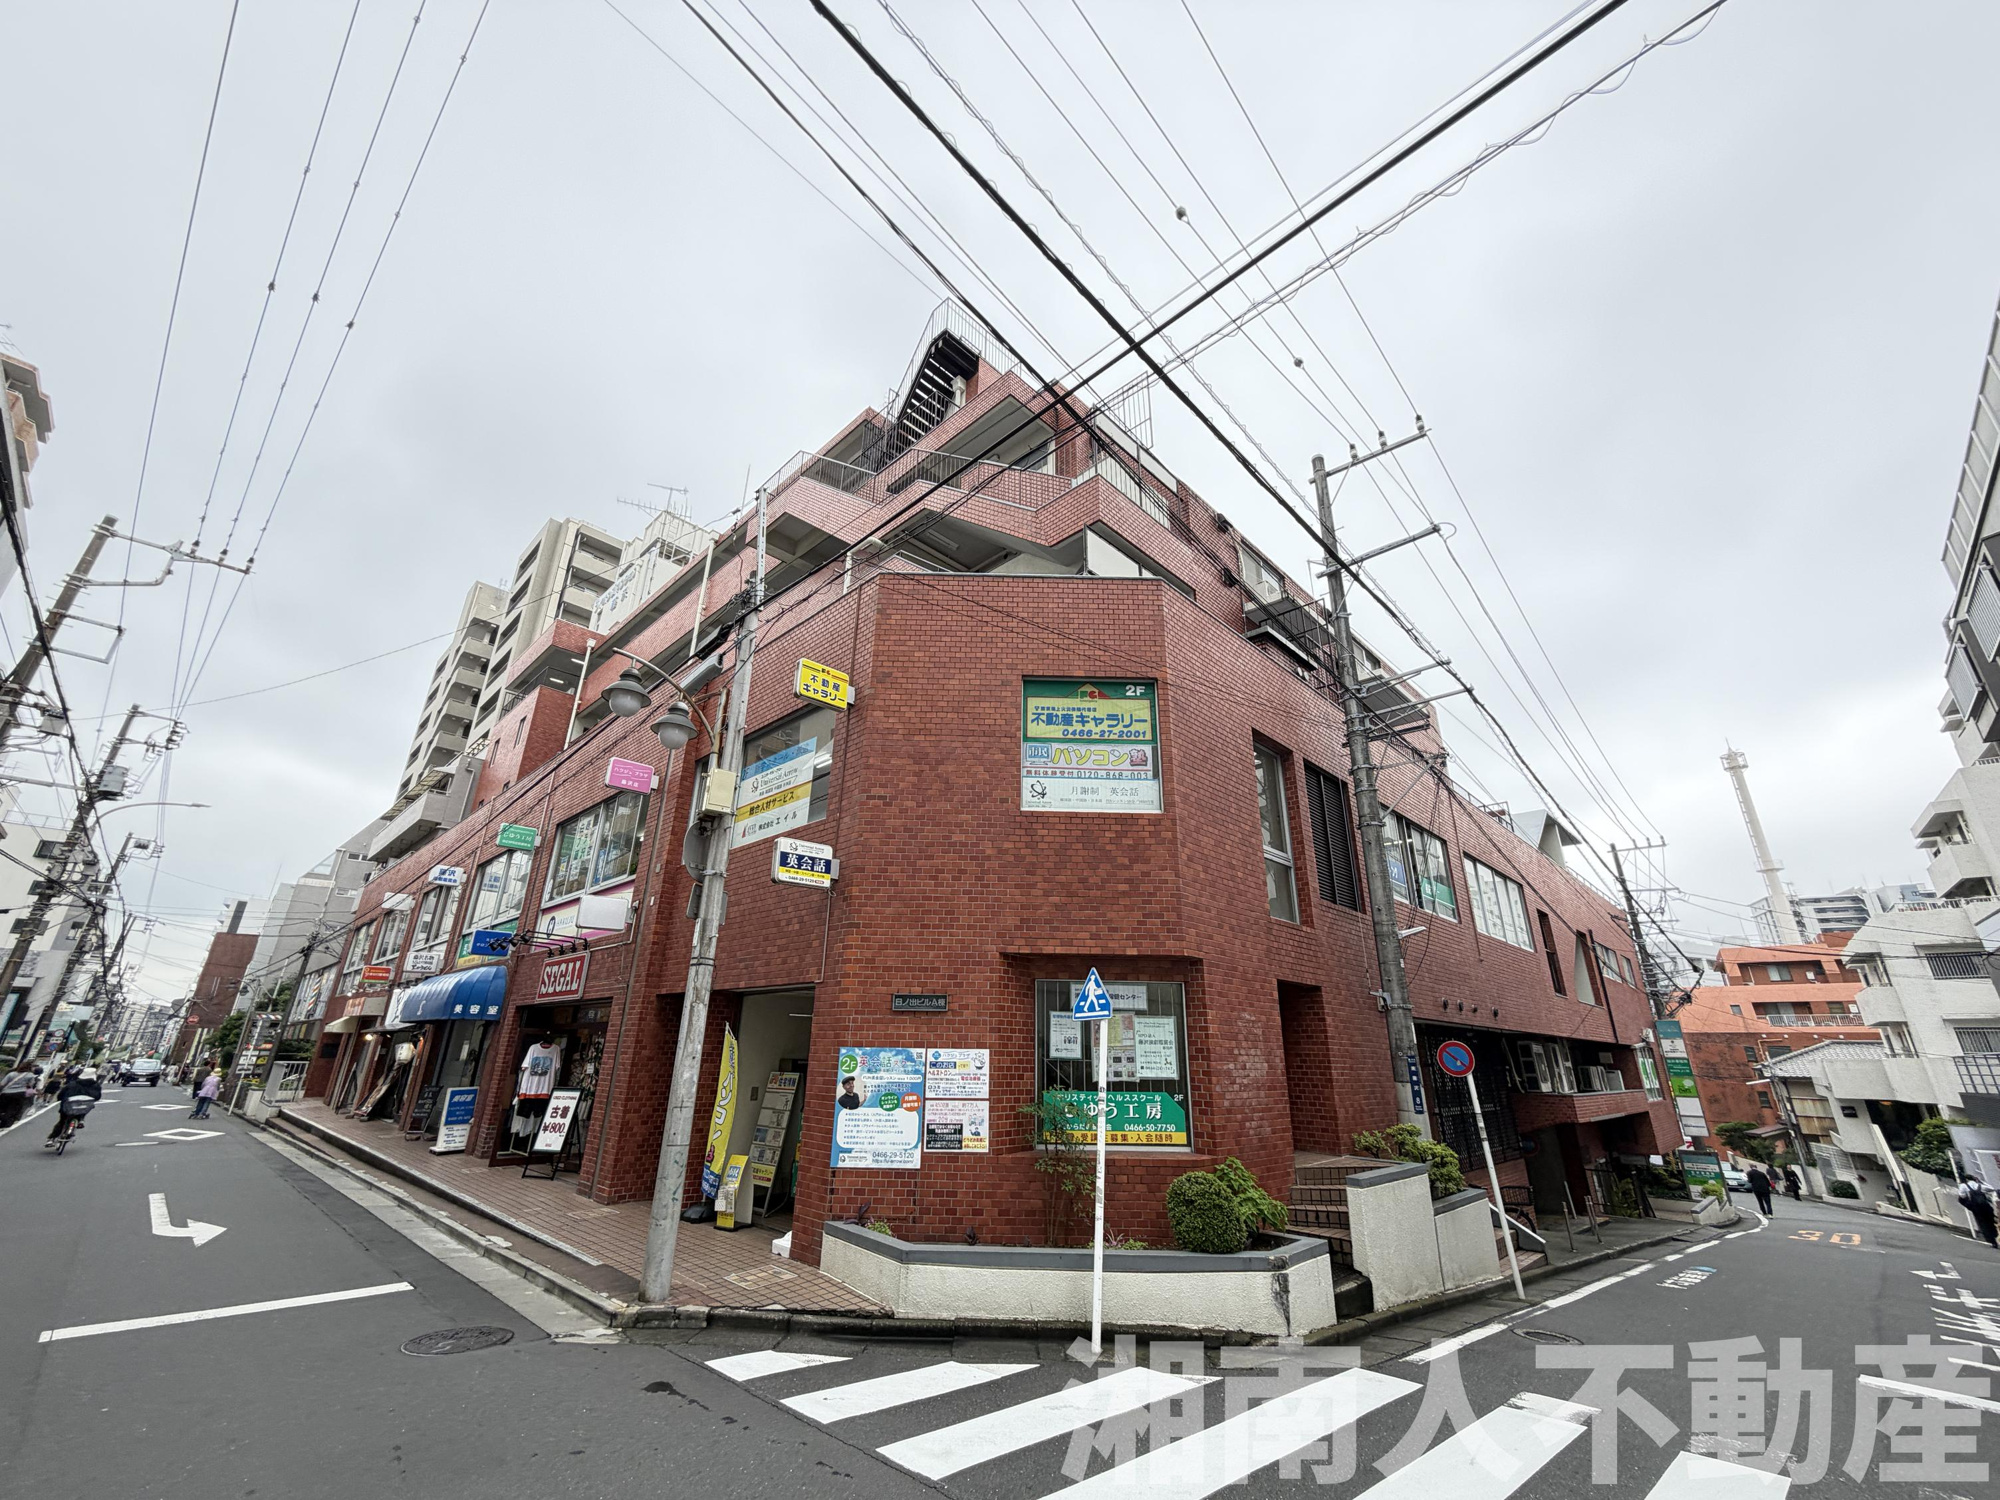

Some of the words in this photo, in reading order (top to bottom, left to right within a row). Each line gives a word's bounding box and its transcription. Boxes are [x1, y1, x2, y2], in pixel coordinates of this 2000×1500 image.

[810, 673, 841, 693] 不動産
[803, 683, 845, 702] ギャラリー
[1125, 685, 1146, 697] 2F
[1030, 712, 1148, 729] 不動産ギャラリー
[1062, 729, 1147, 739] 0466-27-2001
[1071, 786, 1099, 796] 月謝制
[1110, 787, 1139, 797] 英会話
[748, 791, 795, 815] 総合人材サービス
[786, 853, 826, 872] 英会話
[540, 960, 581, 995] SEGAL
[895, 997, 946, 1007] 日ノ出ビルA棟
[453, 1004, 499, 1015] 美容室
[841, 1057, 857, 1071] 2F
[1057, 1093, 1161, 1102] リスティッヘルススクール
[1173, 1094, 1184, 1102] 2F
[550, 1105, 571, 1119] 古着
[1124, 1123, 1176, 1132] 0466-50-7750
[872, 1151, 915, 1159] 0466-29-5120
